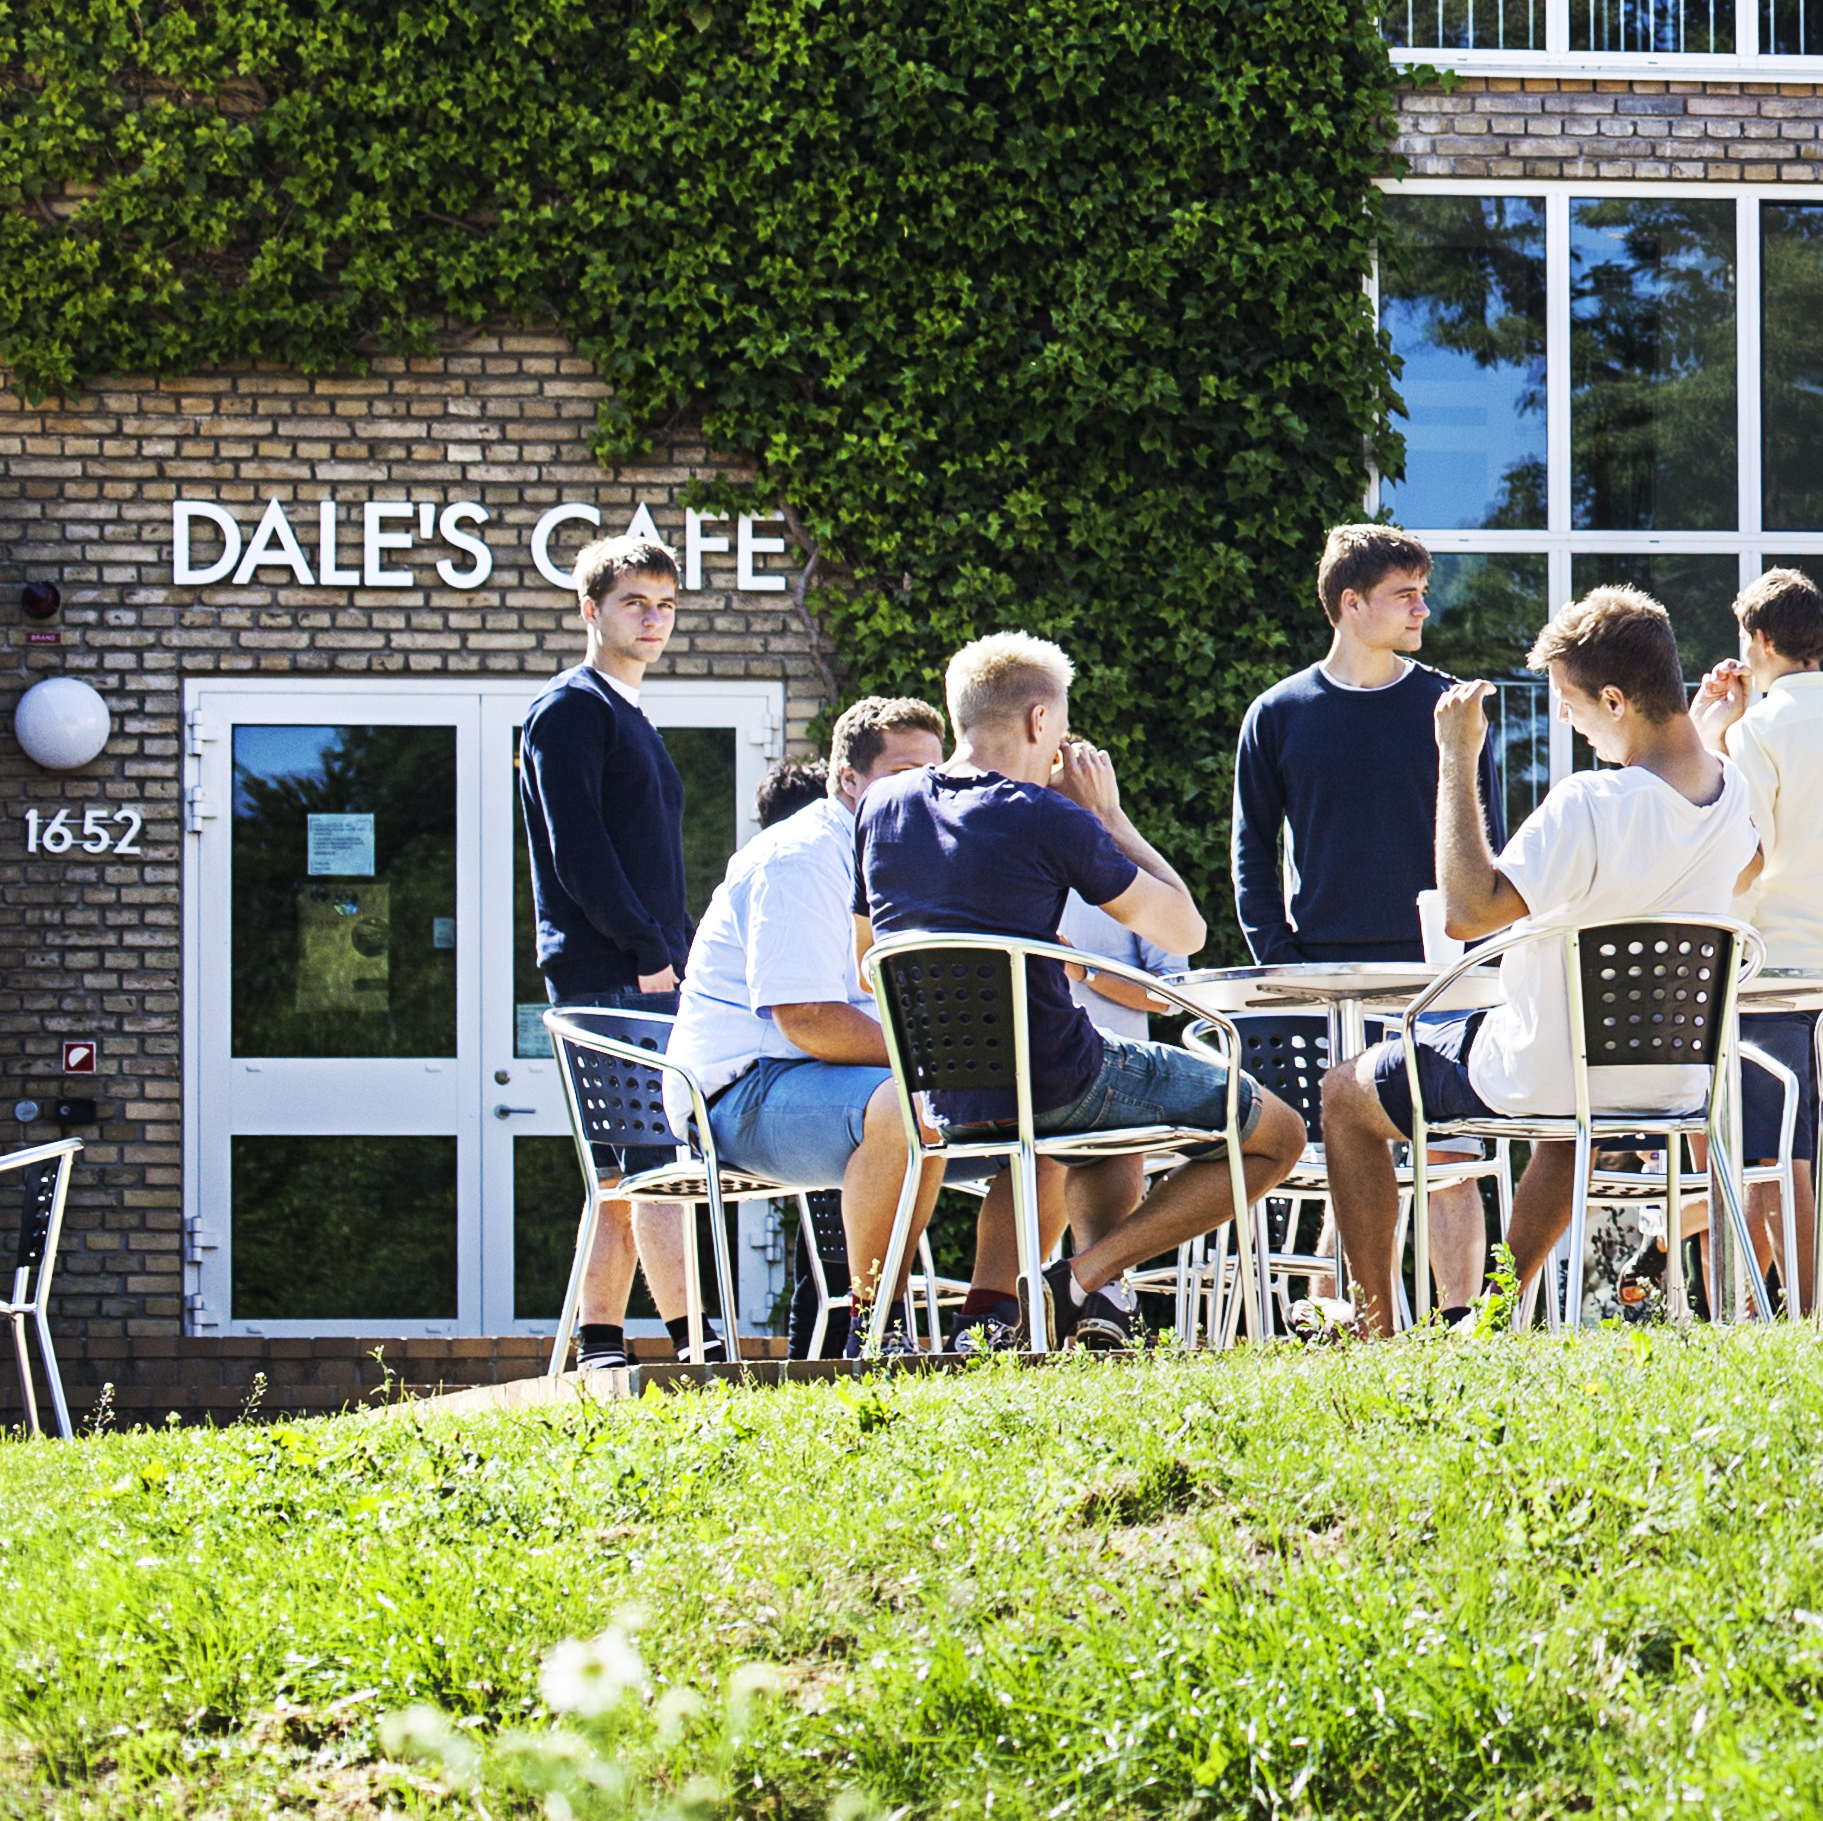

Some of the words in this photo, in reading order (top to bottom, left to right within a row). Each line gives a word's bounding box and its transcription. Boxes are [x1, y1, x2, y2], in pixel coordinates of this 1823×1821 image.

[173, 496, 493, 589] DALE'S
[31, 633, 56, 642] BRAND
[24, 808, 142, 855] 1652
